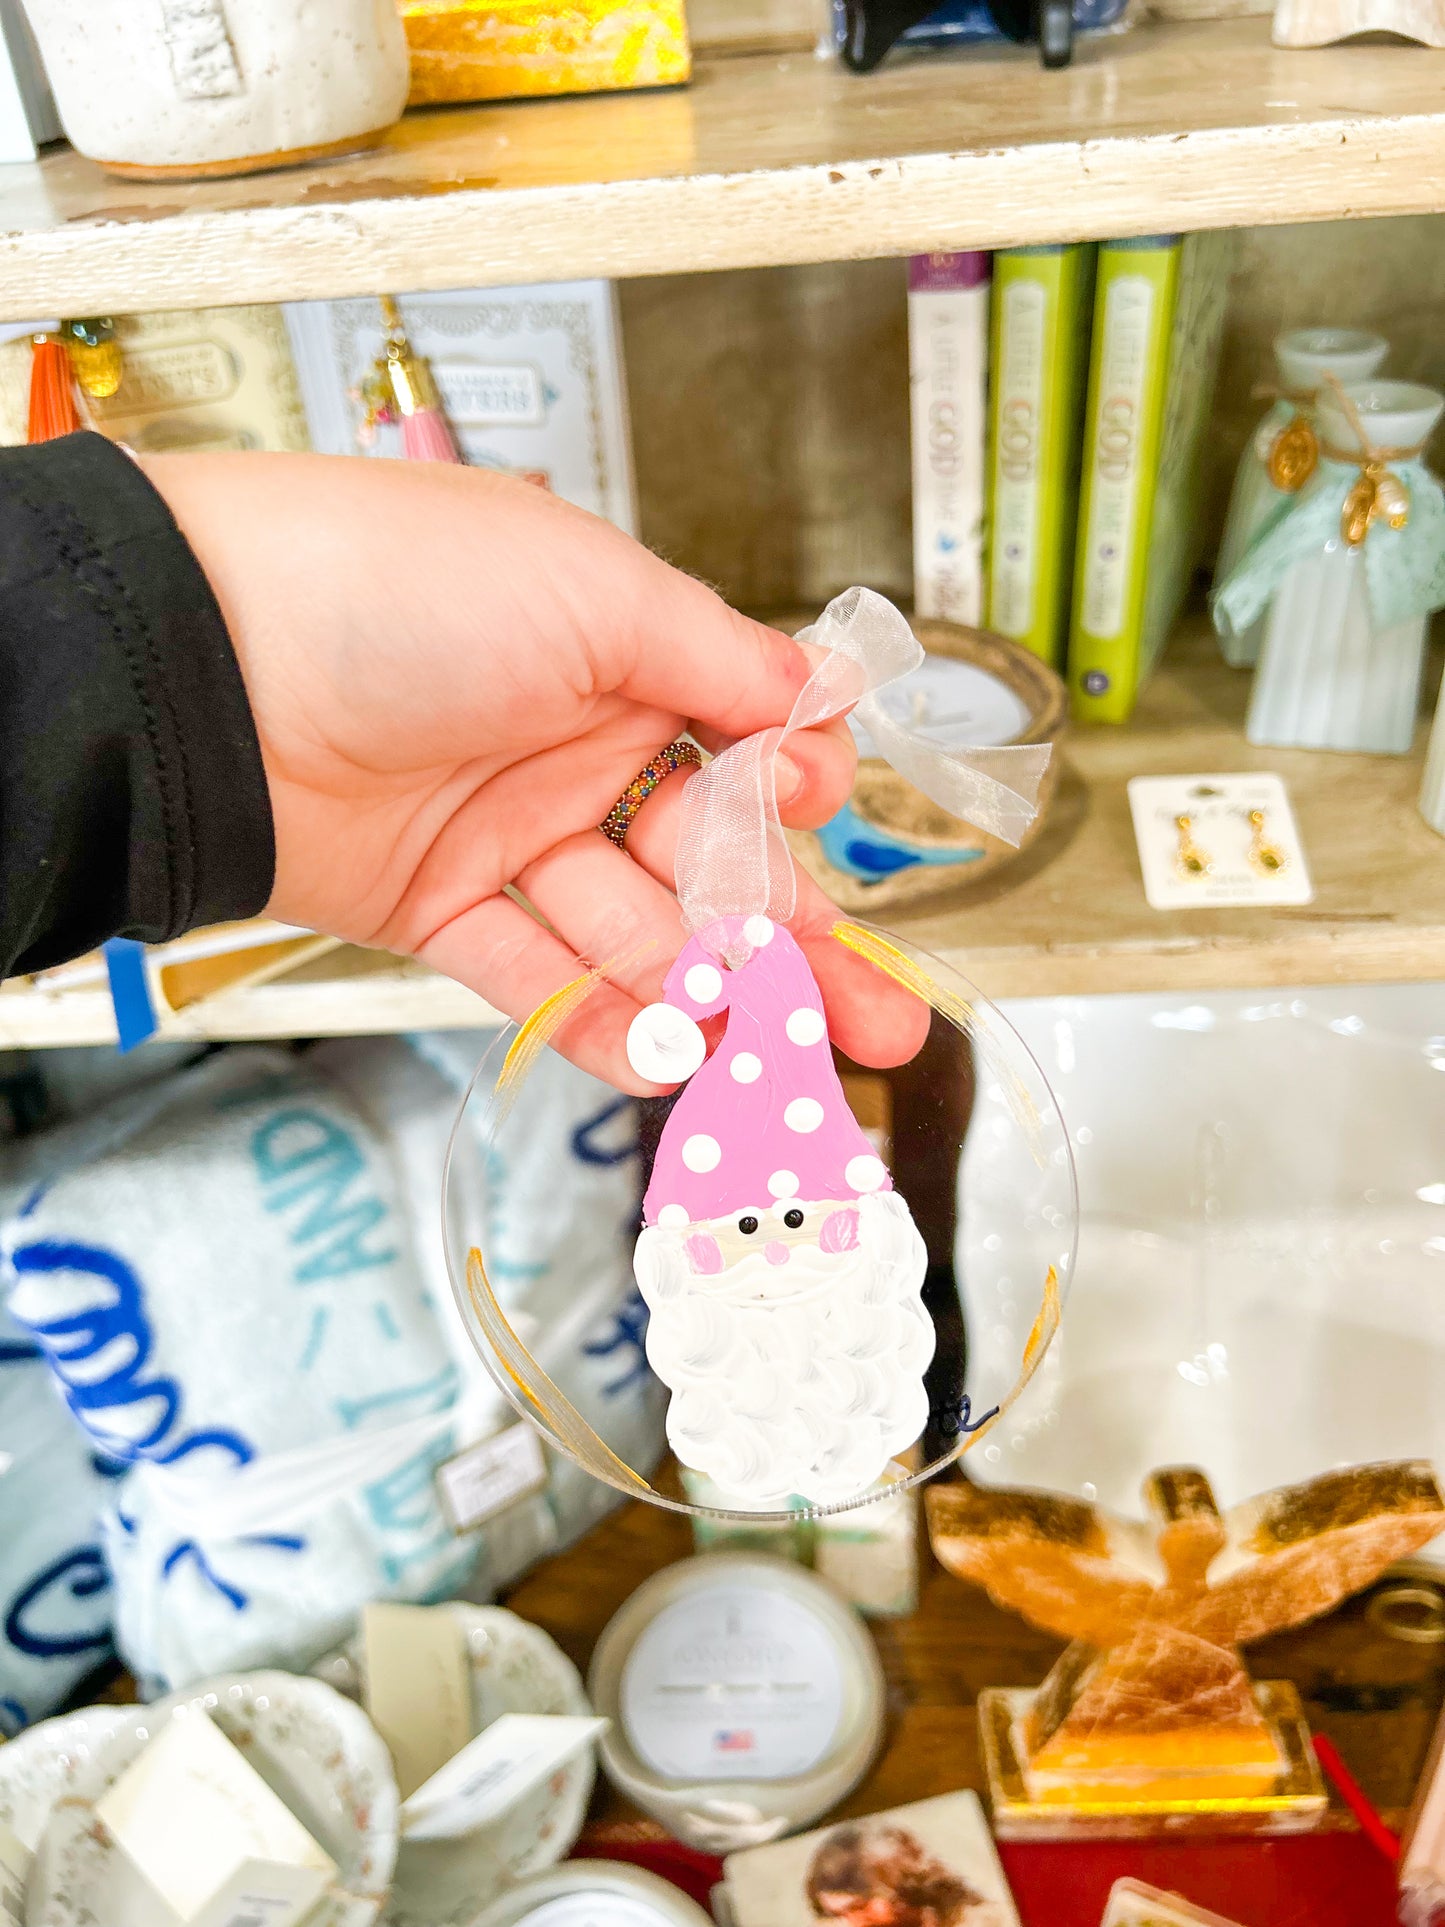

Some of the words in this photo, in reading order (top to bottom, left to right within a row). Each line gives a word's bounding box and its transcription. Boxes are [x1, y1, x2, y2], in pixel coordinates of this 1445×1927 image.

[928, 398, 963, 476] GOD
[1001, 396, 1034, 483] GOD
[1098, 395, 1136, 482] GOD
[252, 1108, 396, 1284] AND
